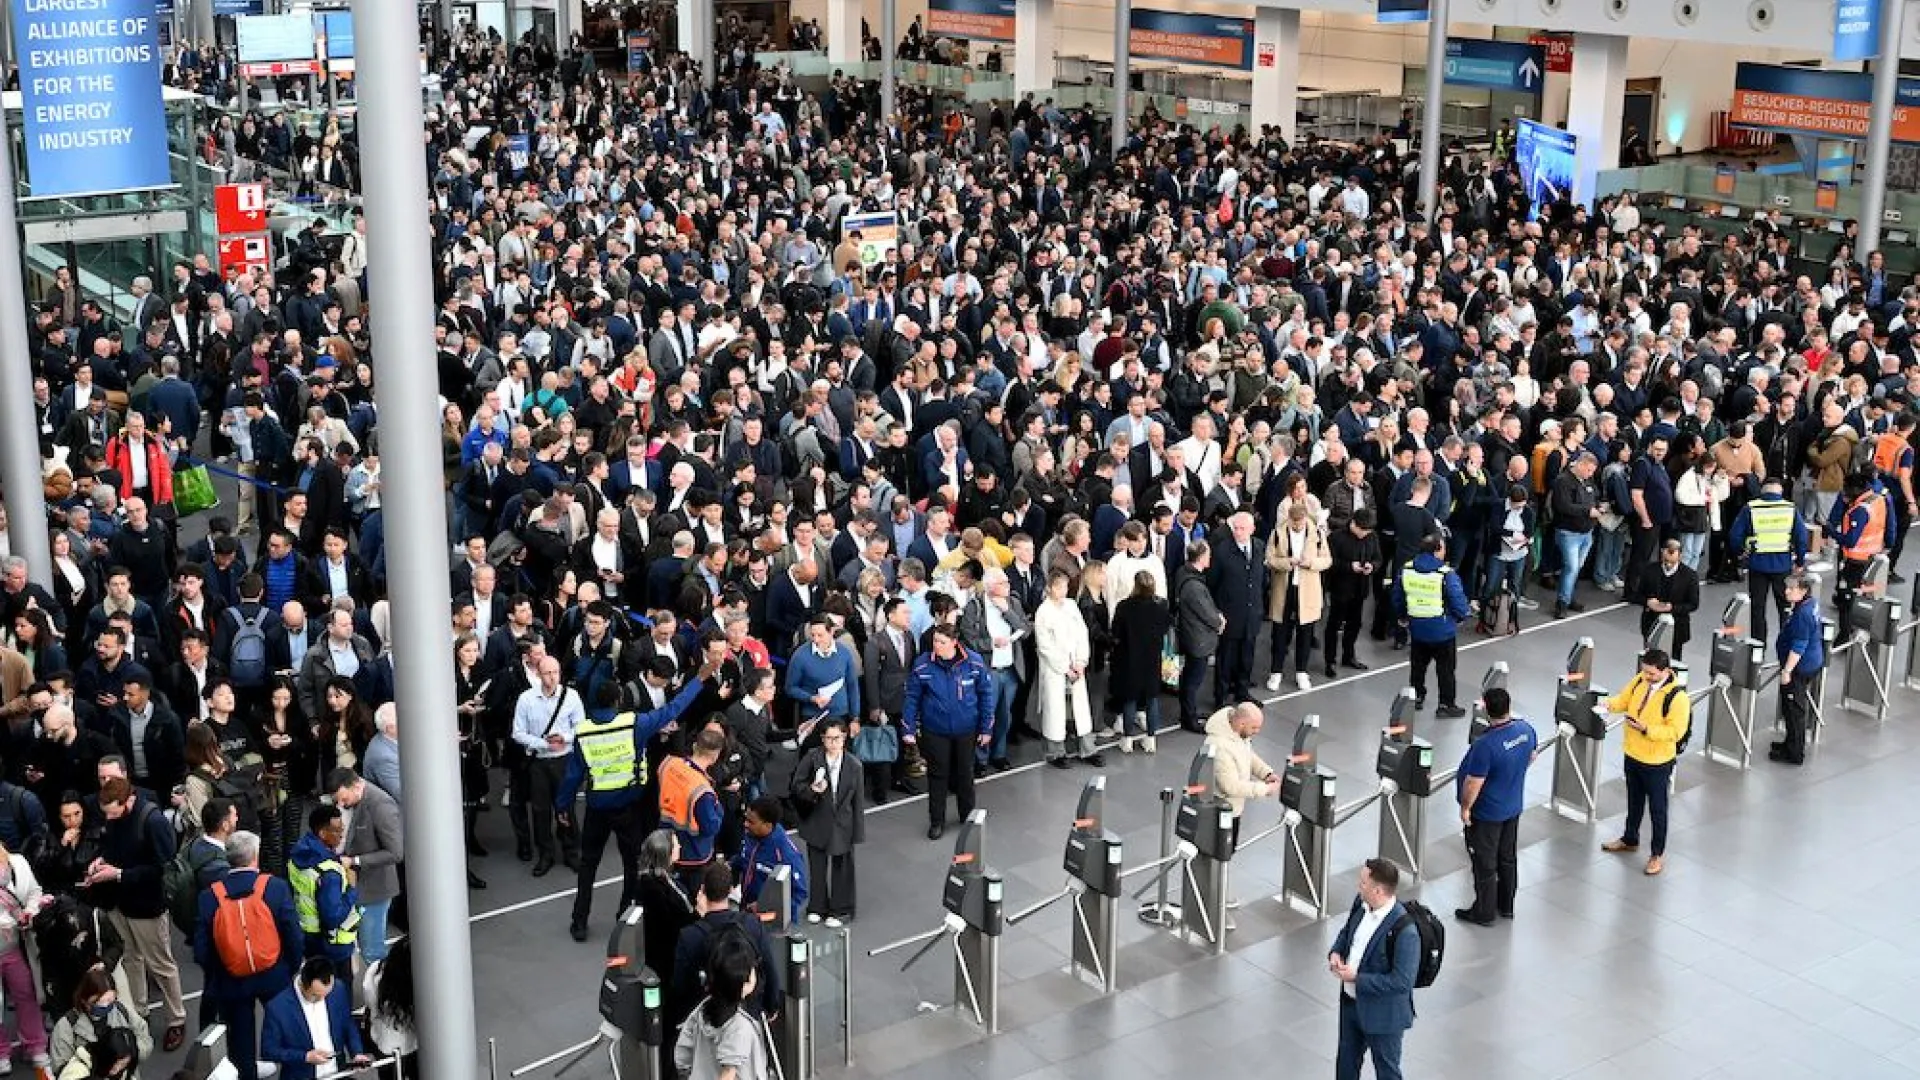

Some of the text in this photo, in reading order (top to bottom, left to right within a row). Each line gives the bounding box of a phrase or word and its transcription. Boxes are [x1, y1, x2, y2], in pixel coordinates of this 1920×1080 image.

[25, 0, 109, 13] LARGEST
[28, 18, 149, 40] ALLIANCE OF
[30, 44, 151, 69] EXHIBITIONS
[33, 75, 115, 96] FOR THE
[36, 102, 112, 123] ENERGY
[1741, 108, 1787, 124] VISITOR
[1742, 93, 1908, 123] BESUCHER-REGISTRIENG
[38, 127, 134, 151] INDUSTRY
